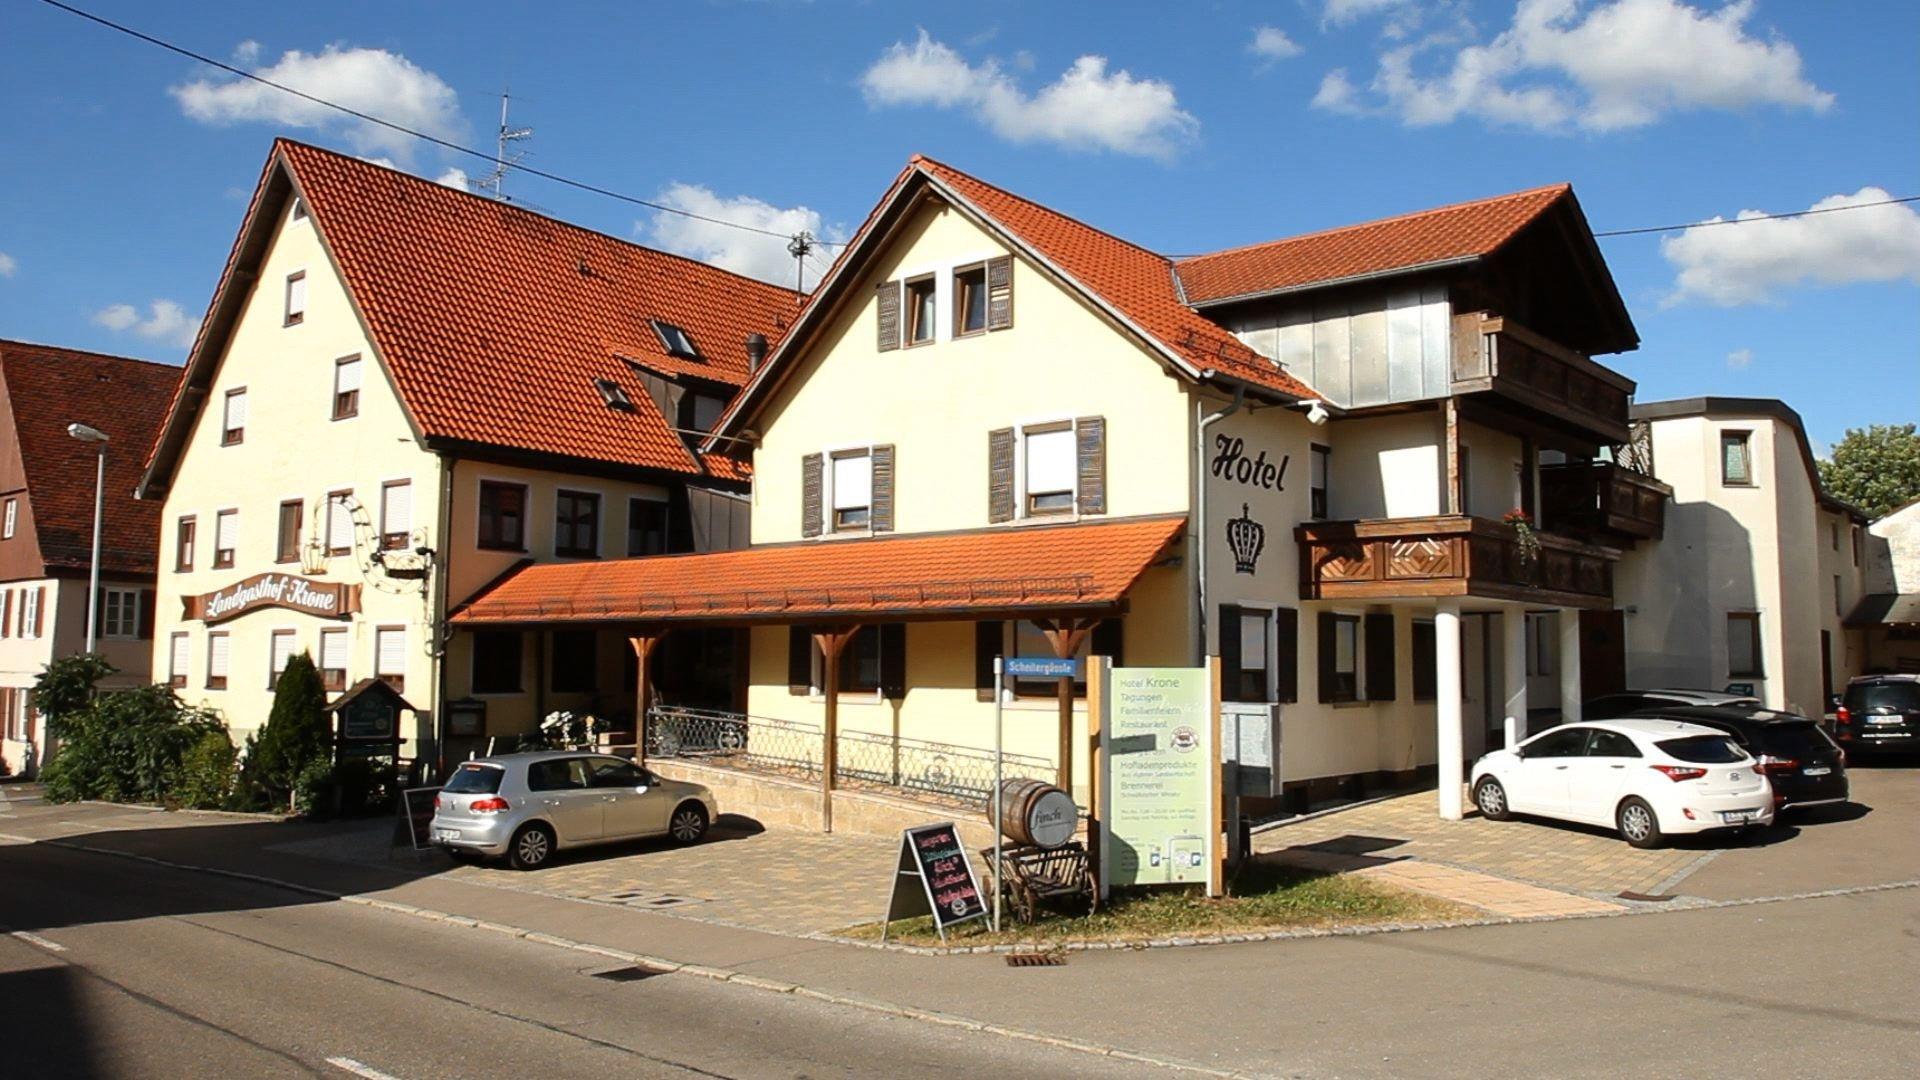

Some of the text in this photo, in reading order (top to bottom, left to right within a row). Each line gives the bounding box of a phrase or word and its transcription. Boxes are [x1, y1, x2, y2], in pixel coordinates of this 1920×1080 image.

[1212, 433, 1290, 491] Hotel
[206, 575, 334, 617] Landgasthof Krone
[1121, 678, 1180, 688] Hotel Krone
[1121, 693, 1163, 703] Tagungen
[1121, 706, 1182, 715] Familienfeiern
[1121, 720, 1168, 729] Restaurant
[1121, 782, 1163, 790] Brennerei
